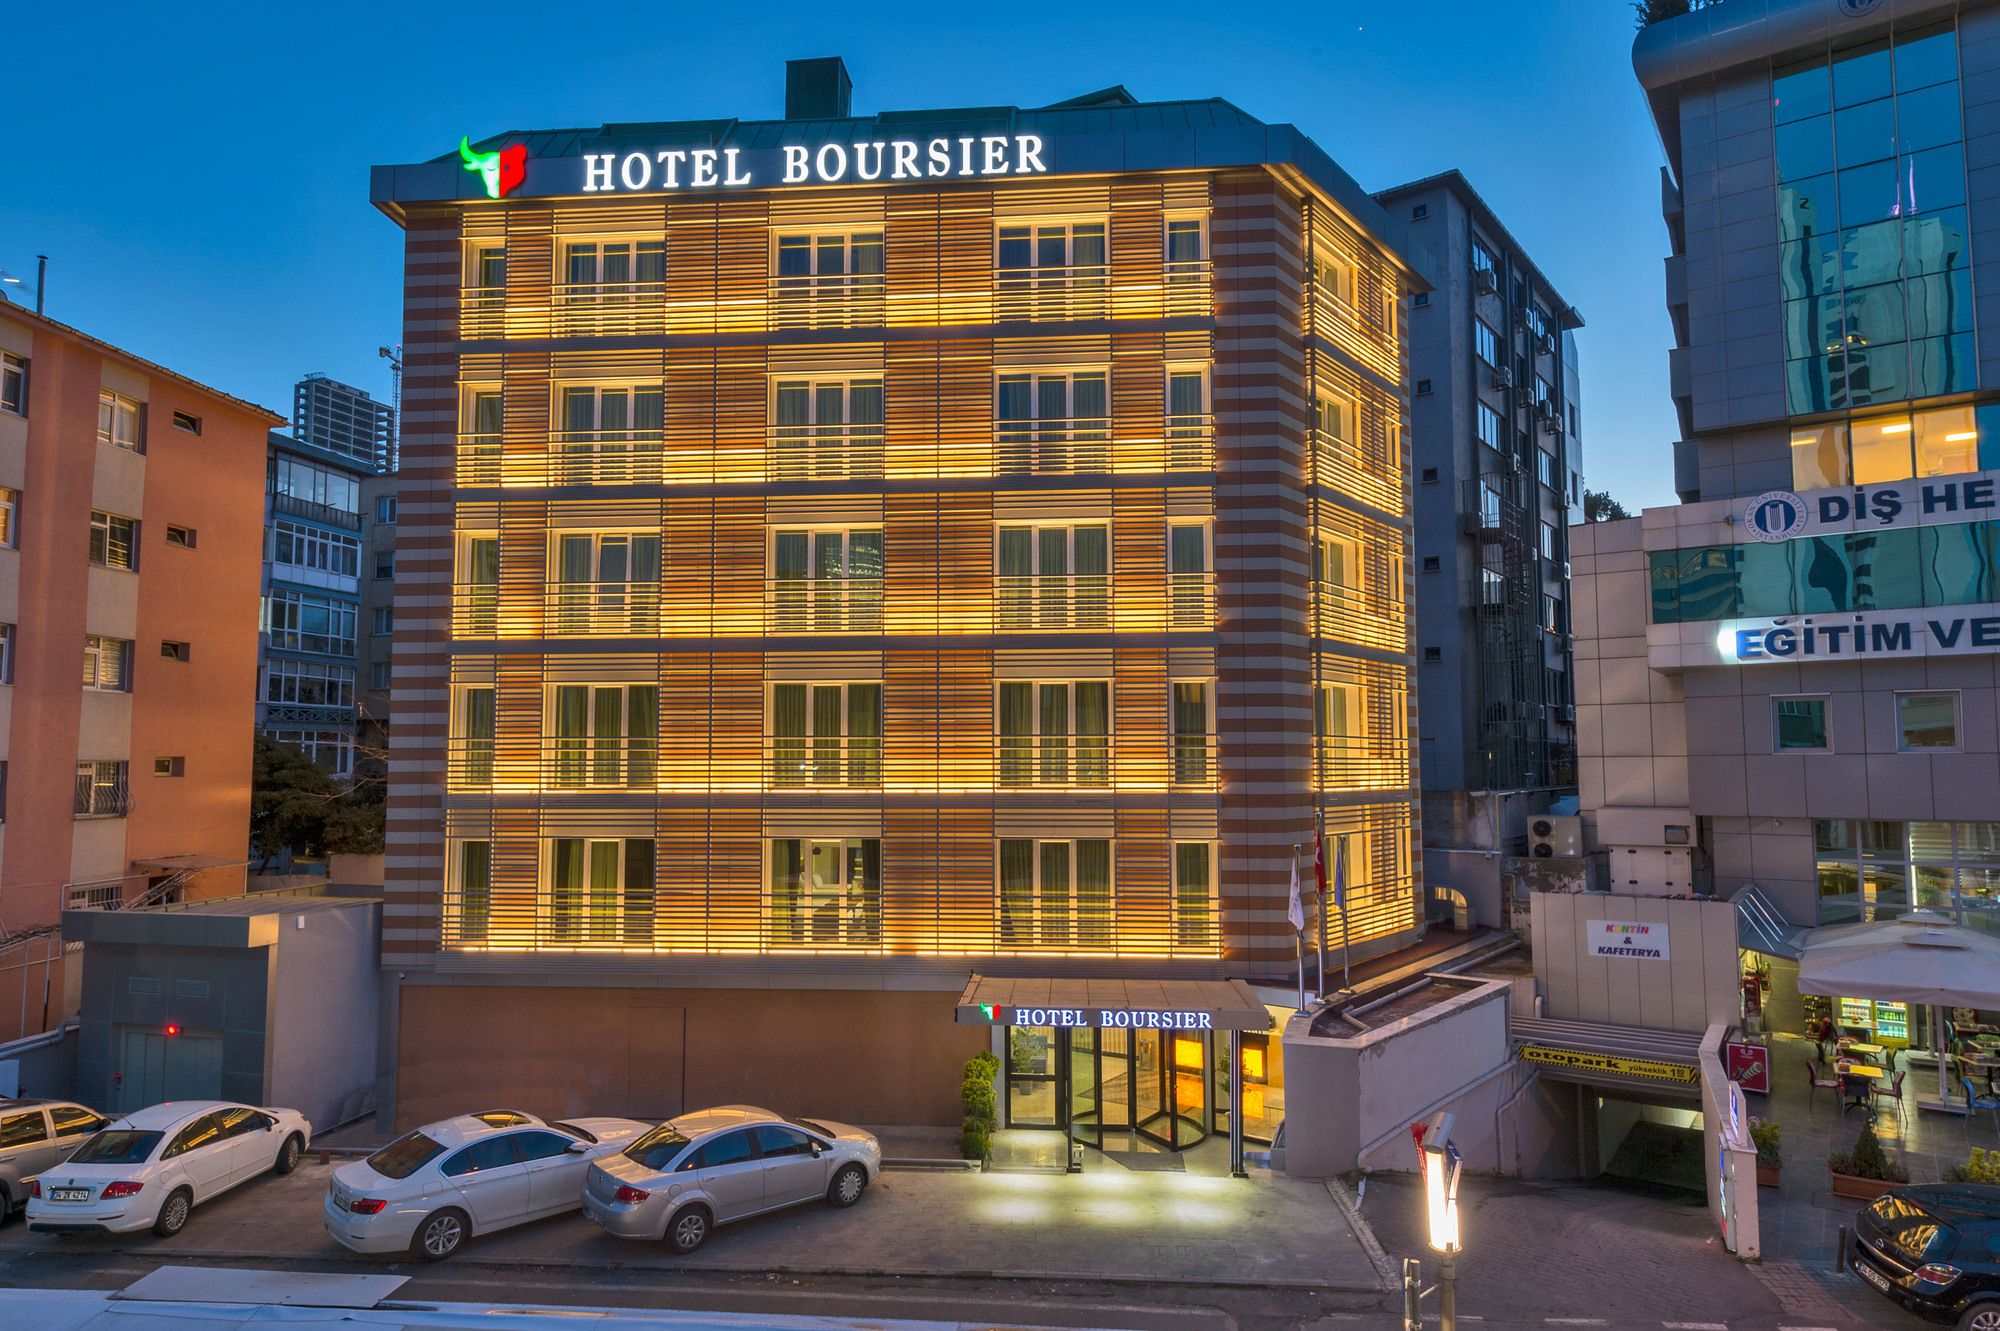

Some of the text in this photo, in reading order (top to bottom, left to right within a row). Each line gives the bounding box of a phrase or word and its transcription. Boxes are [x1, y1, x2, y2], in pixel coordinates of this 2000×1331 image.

[583, 135, 1047, 191] HOTEL BOURSIER
[1818, 479, 1996, 525] DİŞ HE
[1736, 615, 2000, 659] EĞİTİM VE
[1597, 946, 1661, 958] KAFETERYA
[1623, 936, 1633, 945] &
[1015, 1008, 1212, 1029] HOTEL BOURSIER
[1528, 1050, 1622, 1070] otopark
[1628, 1064, 1668, 1076] yükseklik
